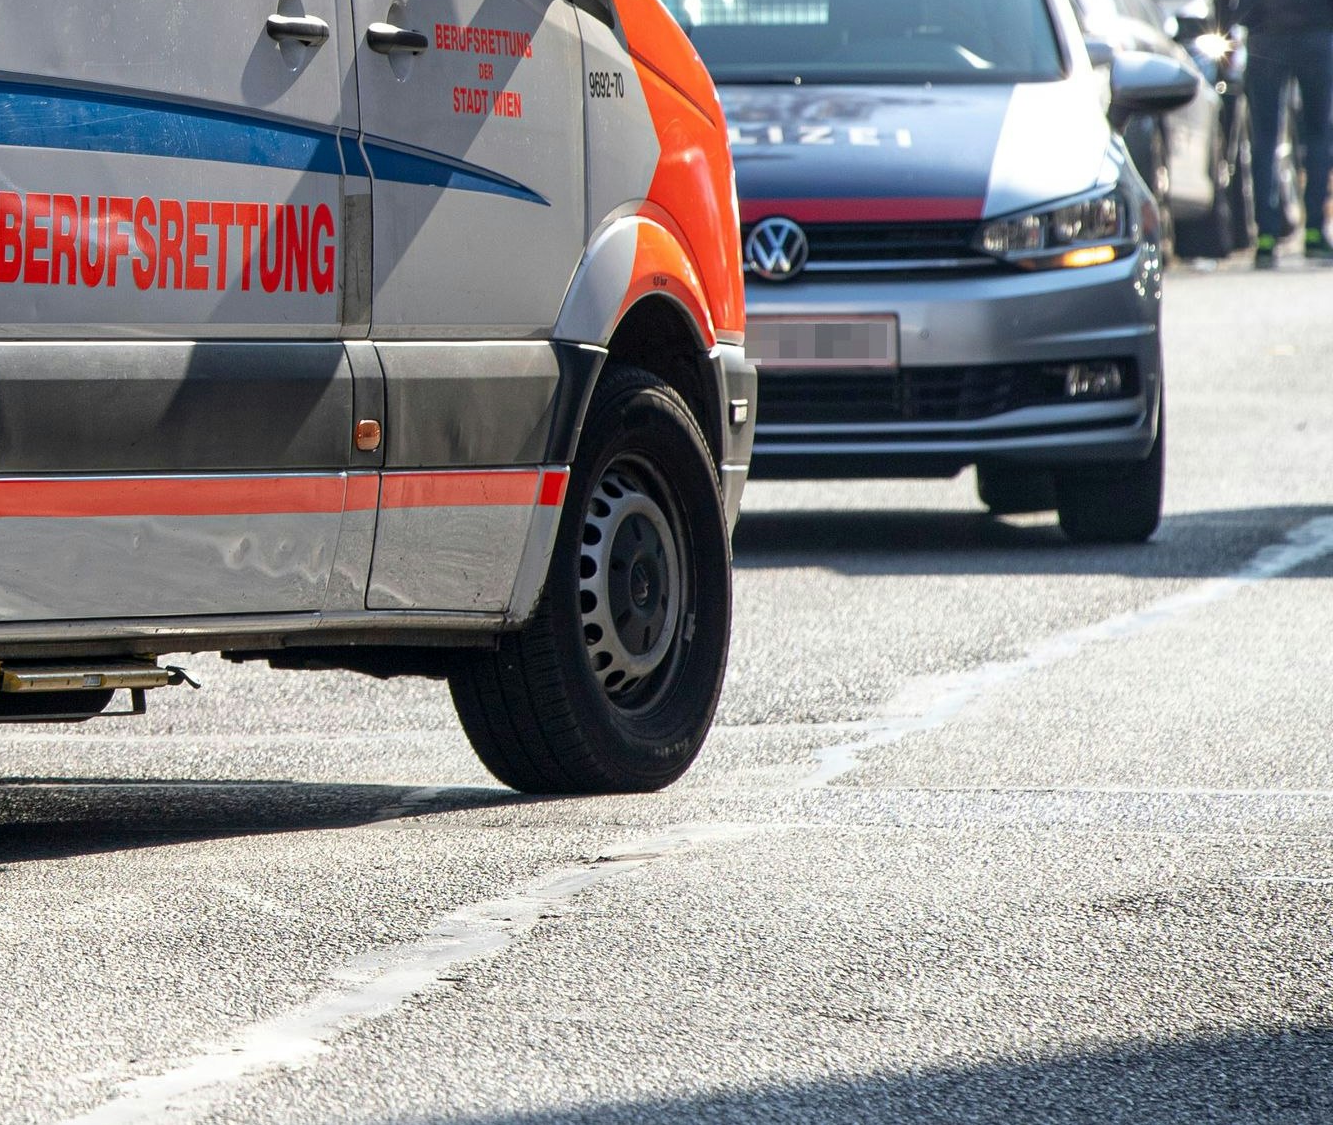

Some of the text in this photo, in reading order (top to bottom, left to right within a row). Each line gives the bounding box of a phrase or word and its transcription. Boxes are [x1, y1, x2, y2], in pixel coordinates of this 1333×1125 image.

[434, 23, 533, 59] BERUFSRETTUNG
[478, 61, 494, 81] DER
[589, 72, 625, 99] 9692-70
[453, 86, 522, 118] STADT WIEN
[726, 125, 912, 148] LIZEI
